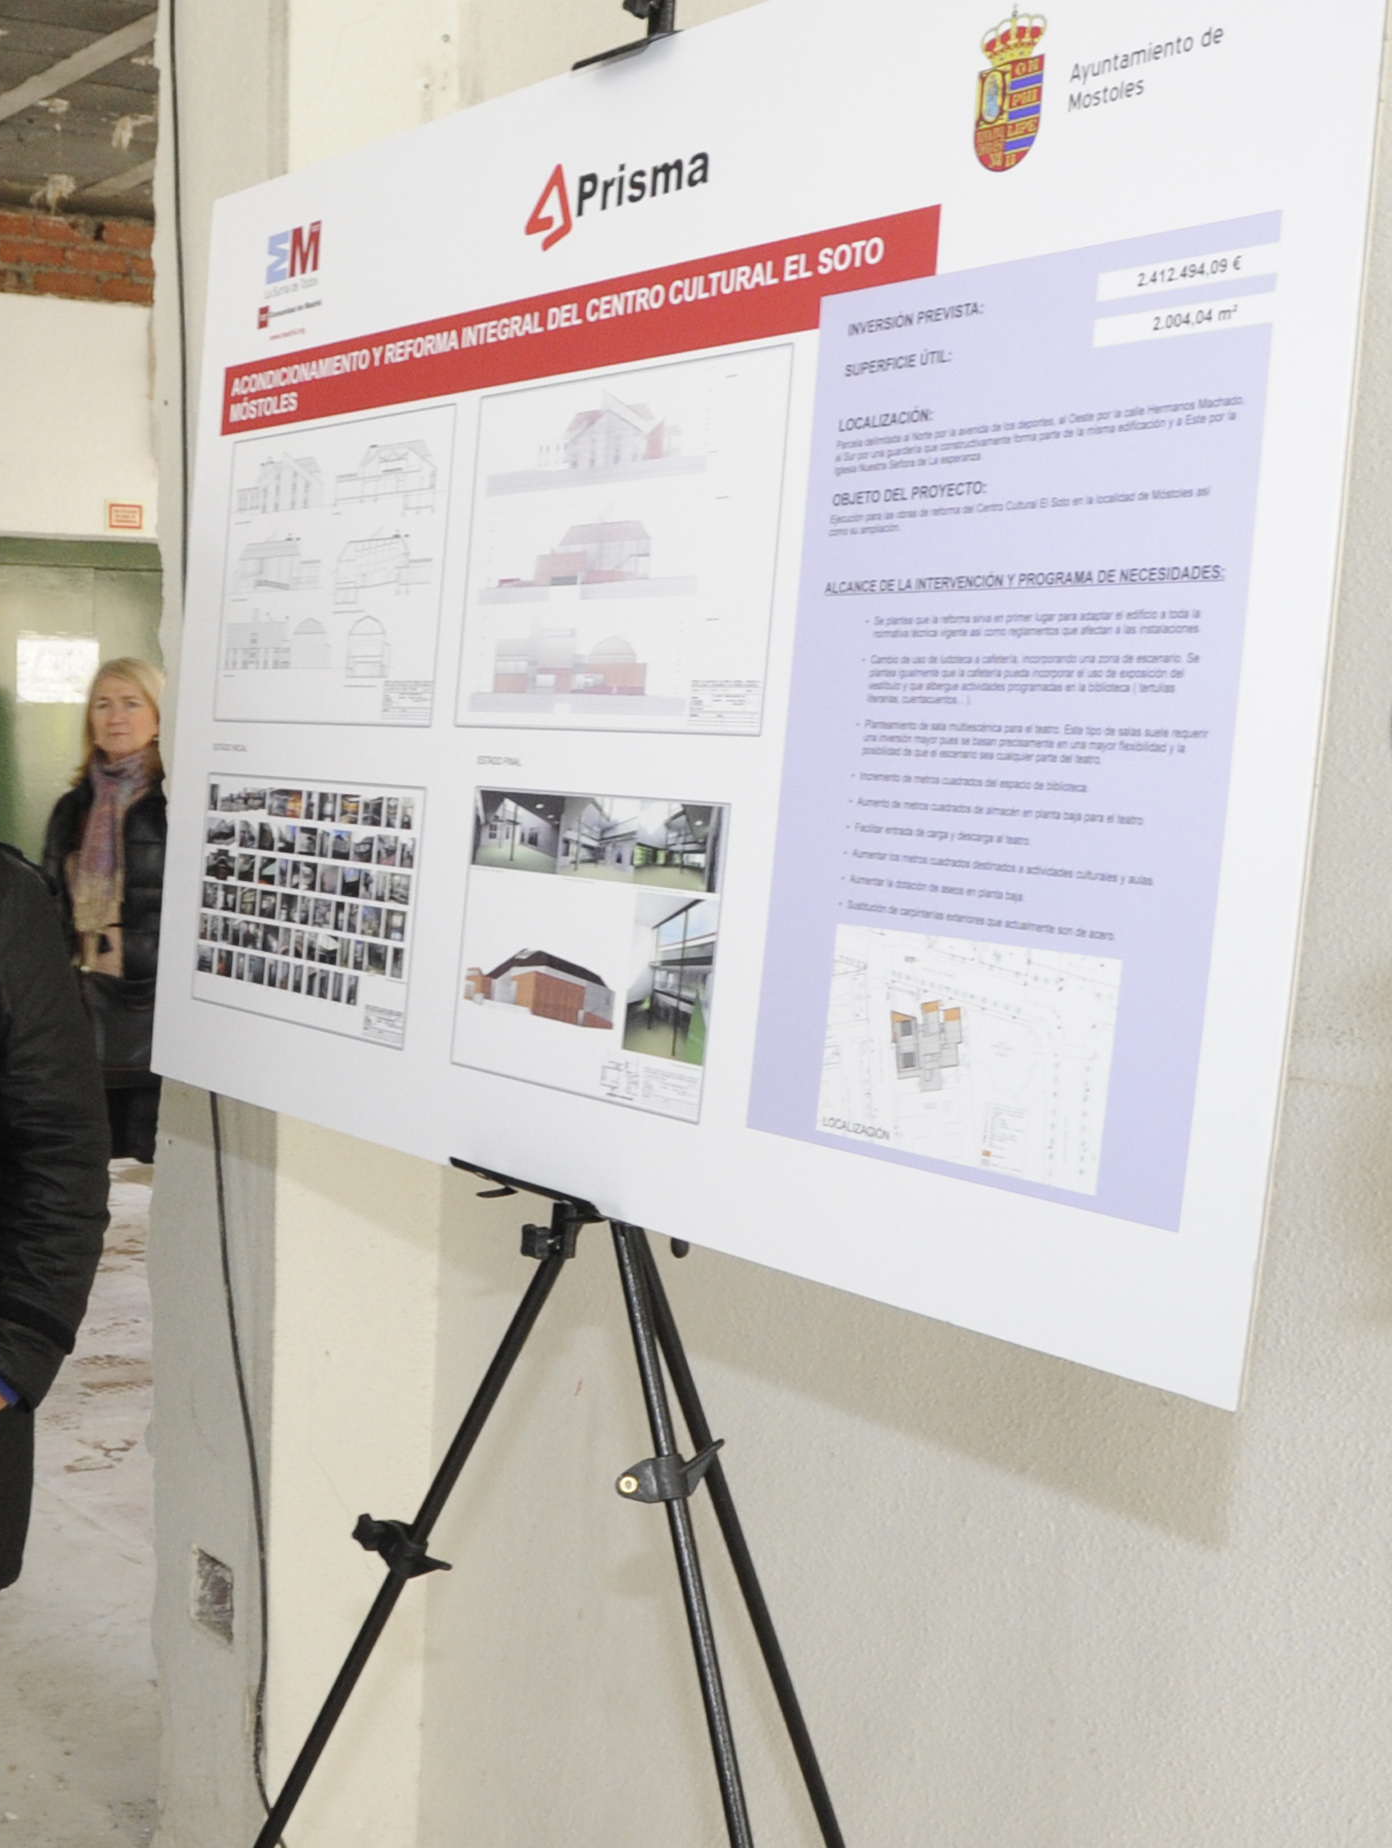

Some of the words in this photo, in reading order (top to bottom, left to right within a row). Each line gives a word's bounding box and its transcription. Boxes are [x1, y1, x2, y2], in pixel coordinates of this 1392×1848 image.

[1069, 36, 1194, 85] Ayuntamiento
[1201, 26, 1224, 48] de
[576, 151, 710, 218] Prisma
[1138, 258, 1227, 287] 2.412.494,09
[1232, 255, 1240, 270] €
[231, 348, 370, 396] ACONDICIONAMIENTO
[370, 347, 383, 368] Y
[384, 329, 459, 364] REFORMA
[461, 311, 544, 348] INTEGRAL
[546, 302, 583, 331] DEL
[586, 284, 665, 322] CENTRO
[668, 259, 780, 305] CULTURAL
[783, 252, 813, 282] EL
[817, 236, 884, 274] SOTO
[848, 312, 914, 336] INVERSIÓN
[916, 302, 984, 324] PREVISTA:
[844, 353, 915, 377] SUPERFICIE
[919, 348, 953, 366] ÚTIL:
[229, 391, 297, 422] MÓSTOLES
[838, 407, 934, 432] LOCALIZACIÓN:
[832, 489, 880, 506] OBJETO
[883, 487, 906, 502] DEL
[910, 480, 988, 499] PROYECTO:
[825, 579, 876, 594] ALCANCE
[879, 578, 894, 592] DE
[897, 578, 912, 592] LA
[914, 573, 1004, 591] INTERVENCIÓN
[1007, 573, 1014, 587] Y
[1018, 570, 1092, 587] PROGRAMA
[1096, 568, 1114, 582] DE
[1119, 564, 1225, 583] NECESIDADES:
